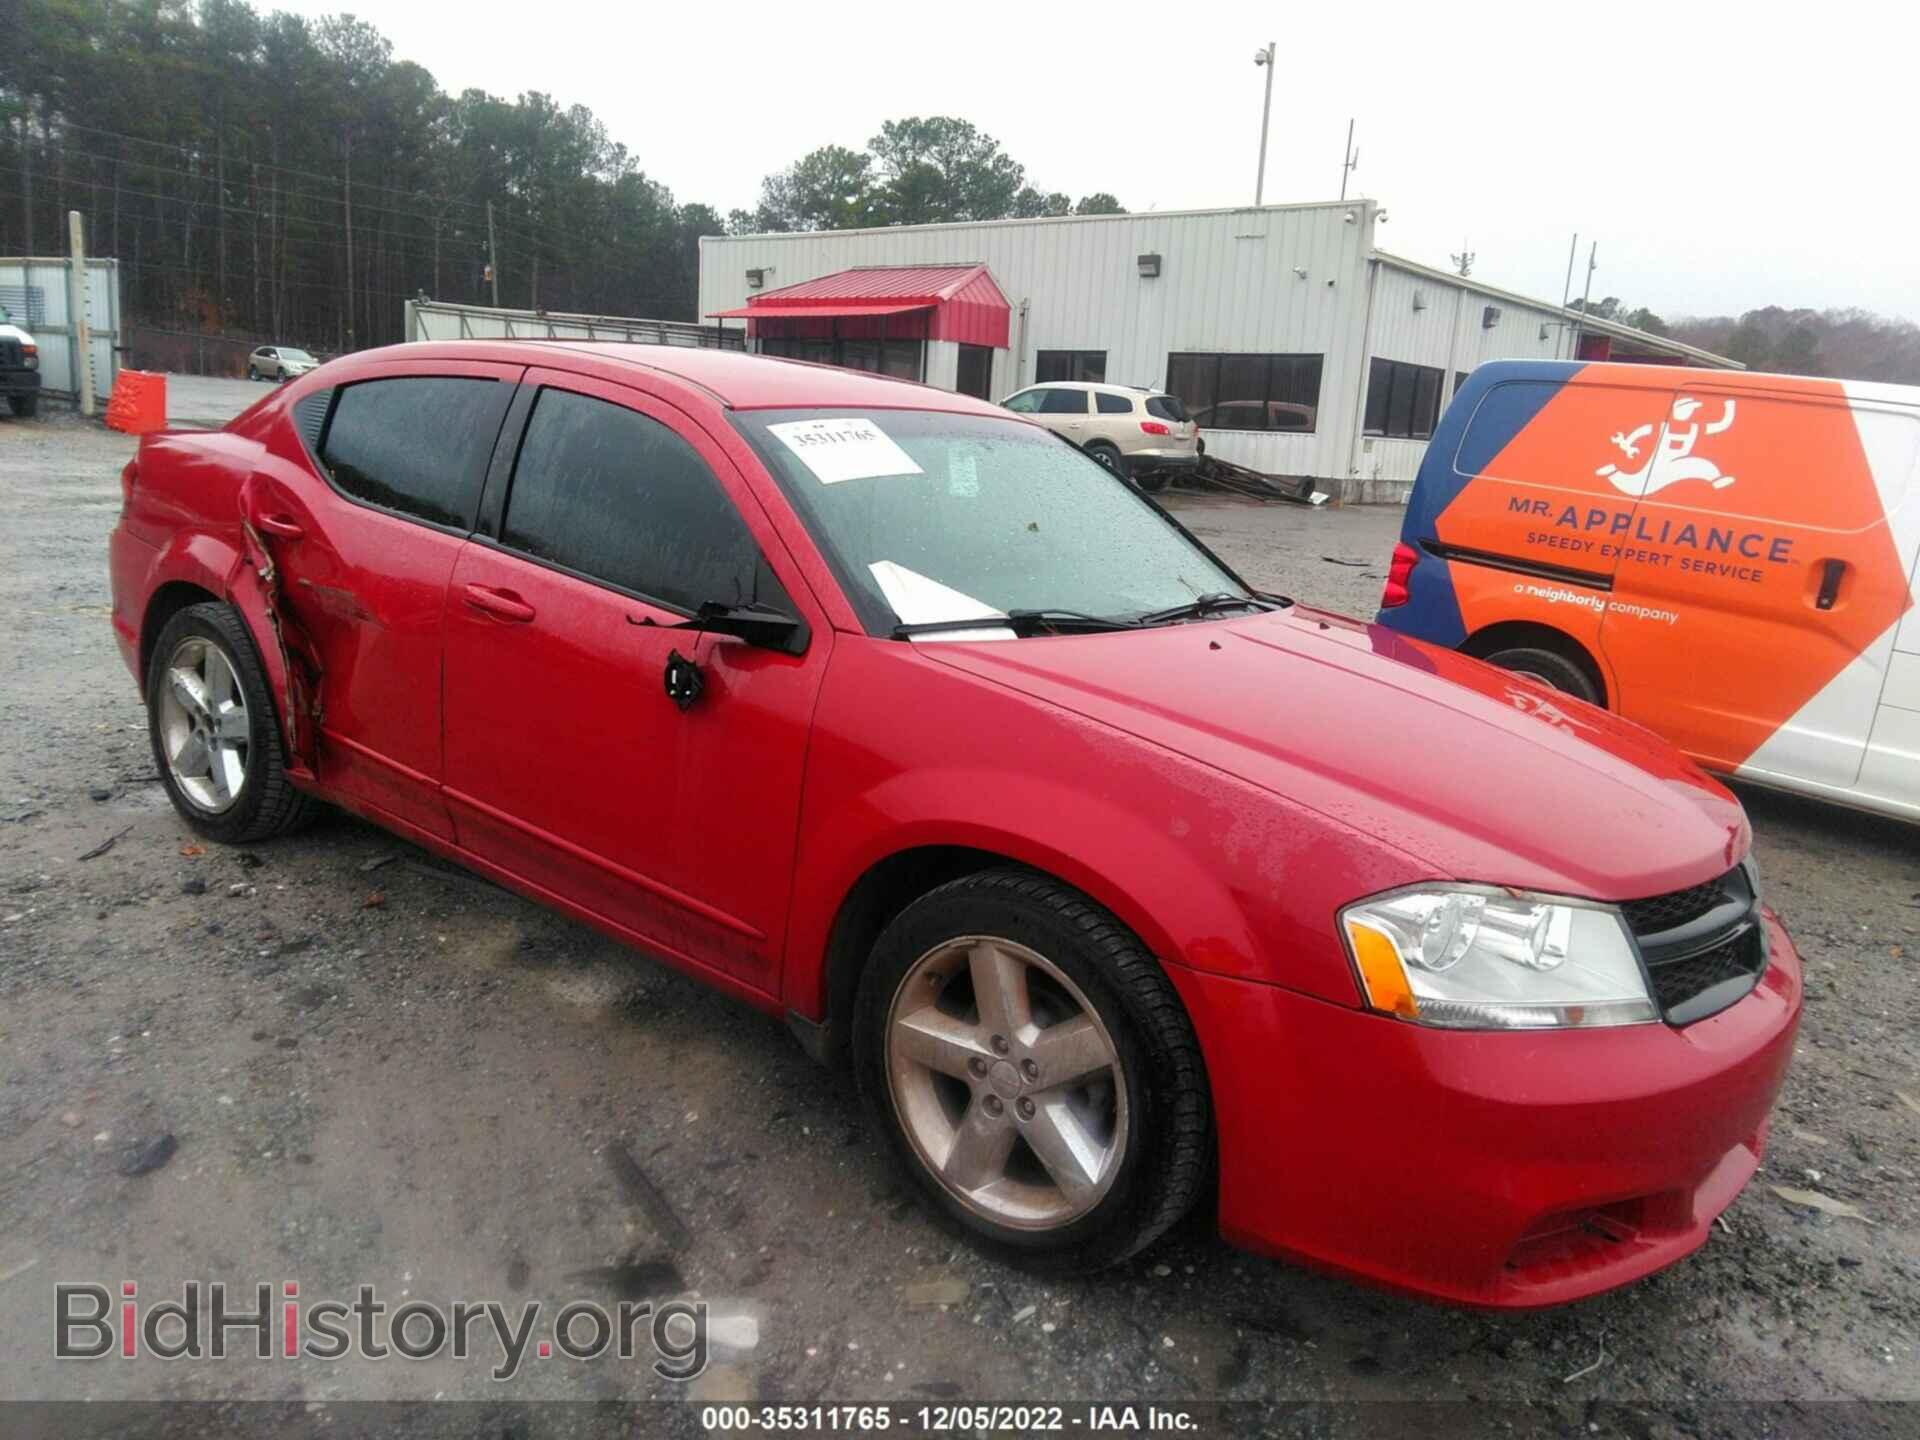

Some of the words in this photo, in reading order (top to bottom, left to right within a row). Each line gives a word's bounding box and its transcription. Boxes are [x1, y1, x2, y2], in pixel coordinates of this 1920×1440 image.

[792, 430, 878, 447] 35311765
[1507, 496, 1553, 518] MR.
[1555, 505, 1794, 564] APPLIANCE
[1526, 531, 1594, 553] SPEEDY
[1600, 544, 1673, 568] EXPERT
[1680, 557, 1763, 584] SERVICE
[1513, 583, 1525, 594] a
[1526, 584, 1605, 612] neighborly
[1609, 600, 1680, 625] company
